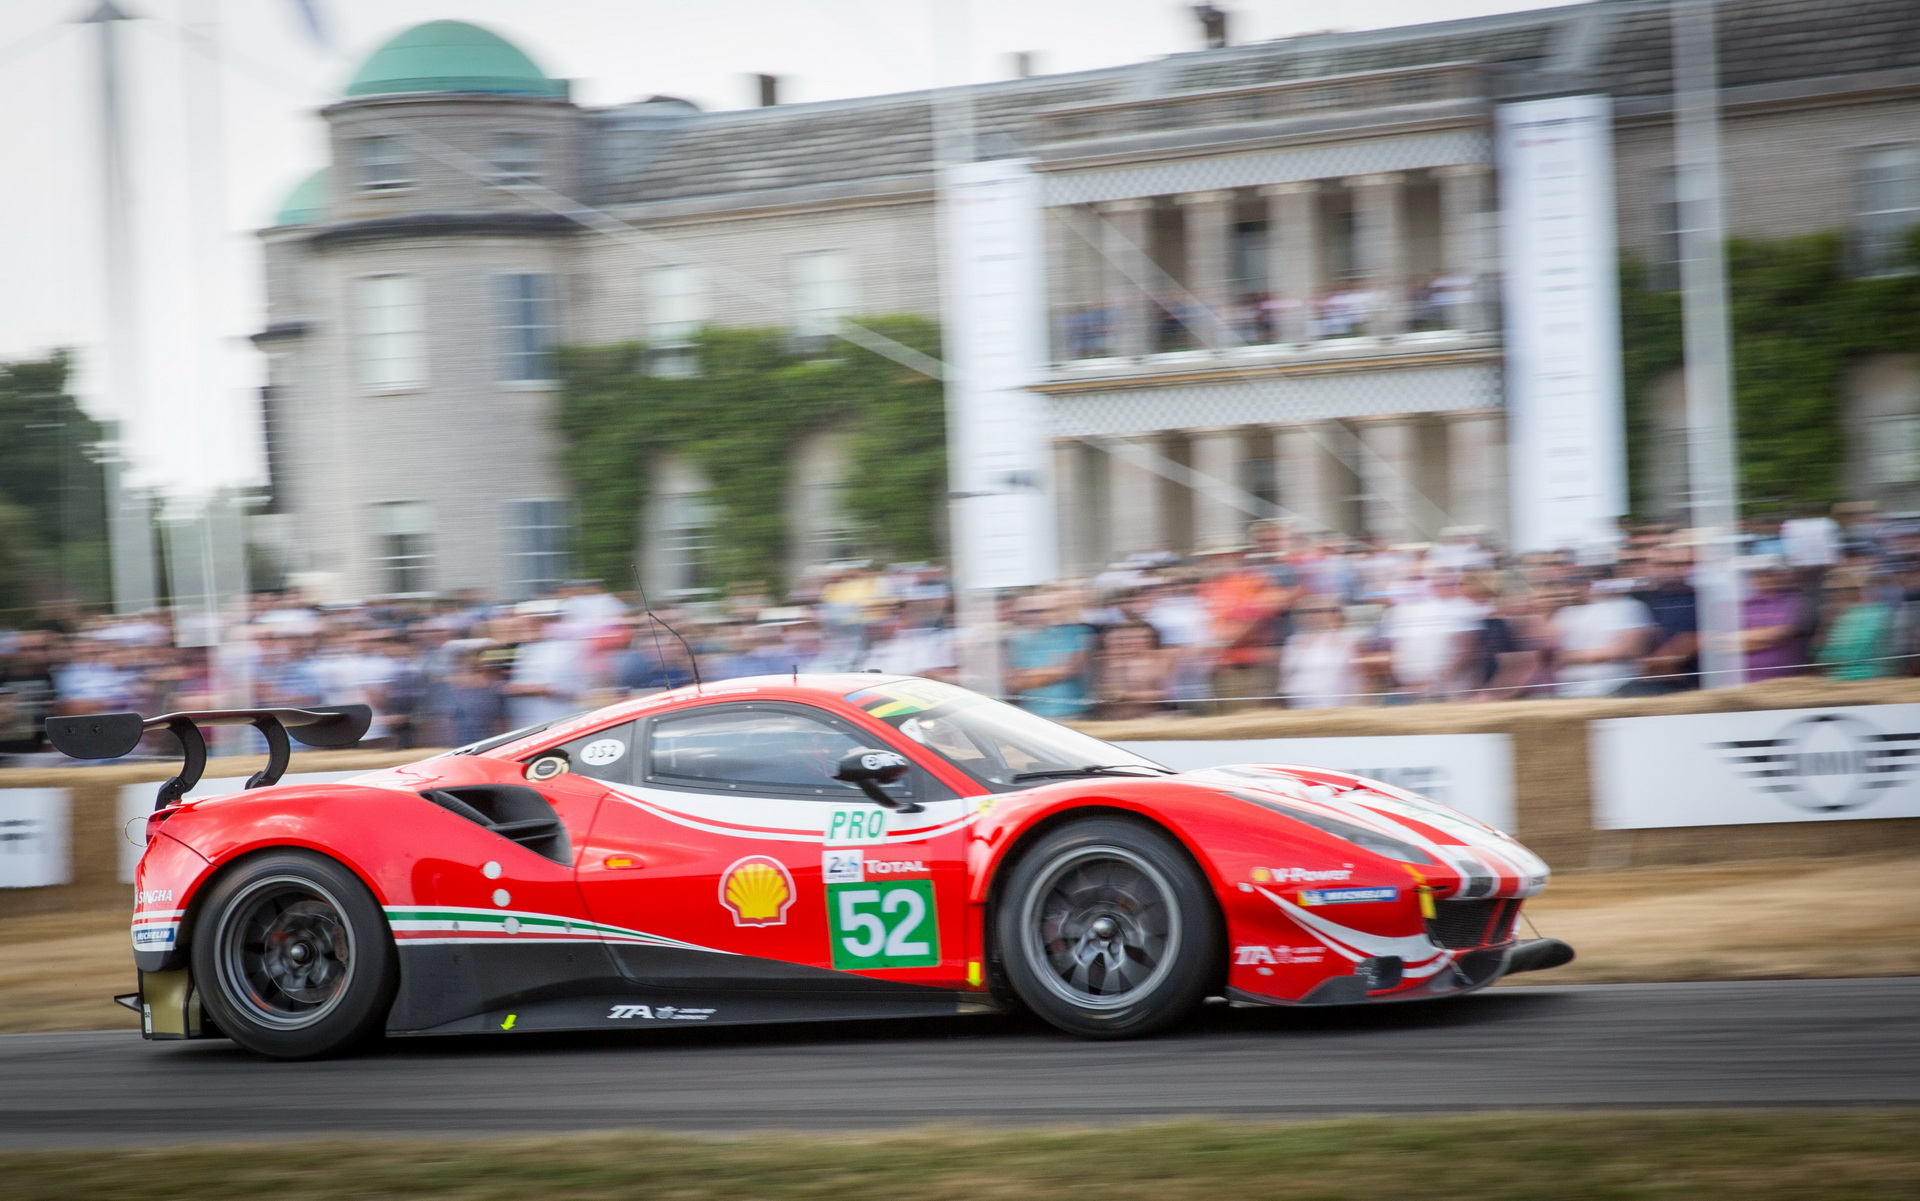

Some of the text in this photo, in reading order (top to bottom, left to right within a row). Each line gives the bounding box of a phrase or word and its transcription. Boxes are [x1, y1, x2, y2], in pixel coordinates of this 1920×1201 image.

[588, 744, 618, 759] 352
[830, 810, 884, 840] PRO
[138, 889, 173, 905] SINGHA
[838, 888, 930, 958] 52
[137, 930, 171, 941] MICHELIN
